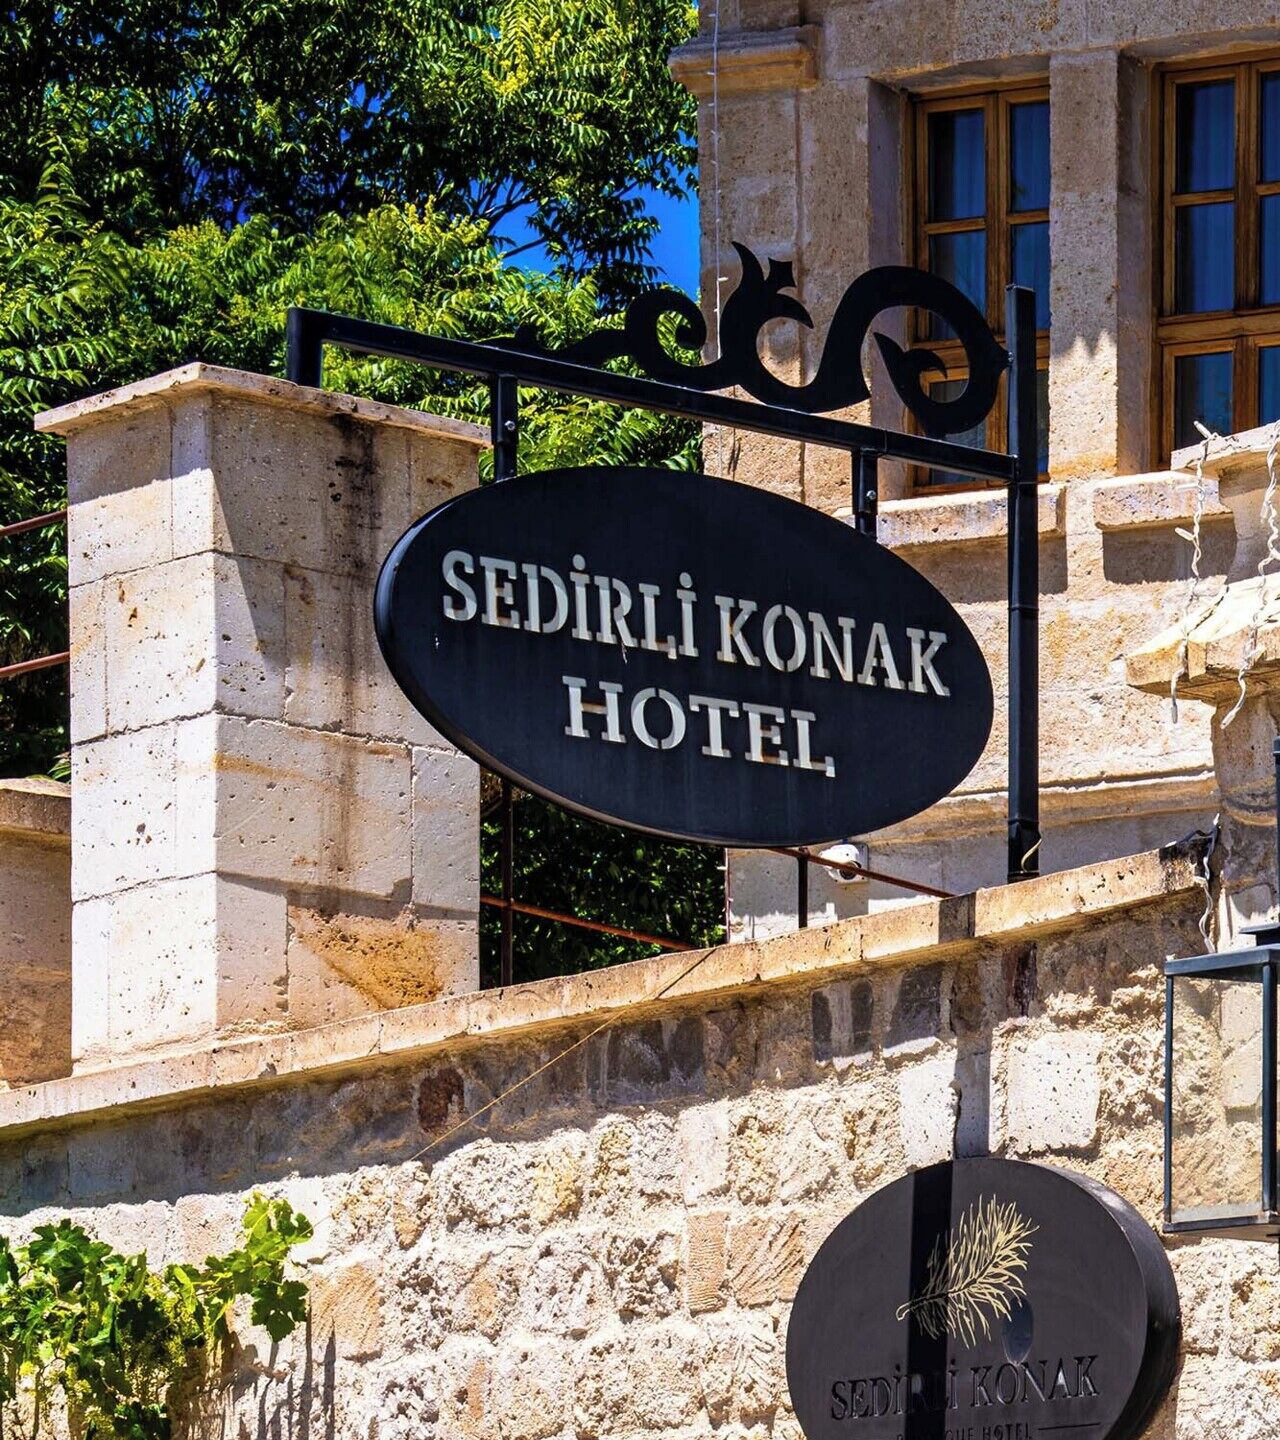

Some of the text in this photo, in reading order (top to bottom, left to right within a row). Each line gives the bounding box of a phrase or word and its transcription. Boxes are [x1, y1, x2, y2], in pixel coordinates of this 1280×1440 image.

[441, 549, 951, 698] SEDİRLİ KONAK
[561, 675, 835, 779] HOTEL
[830, 1354, 1101, 1421] SEDİRİ KONAK
